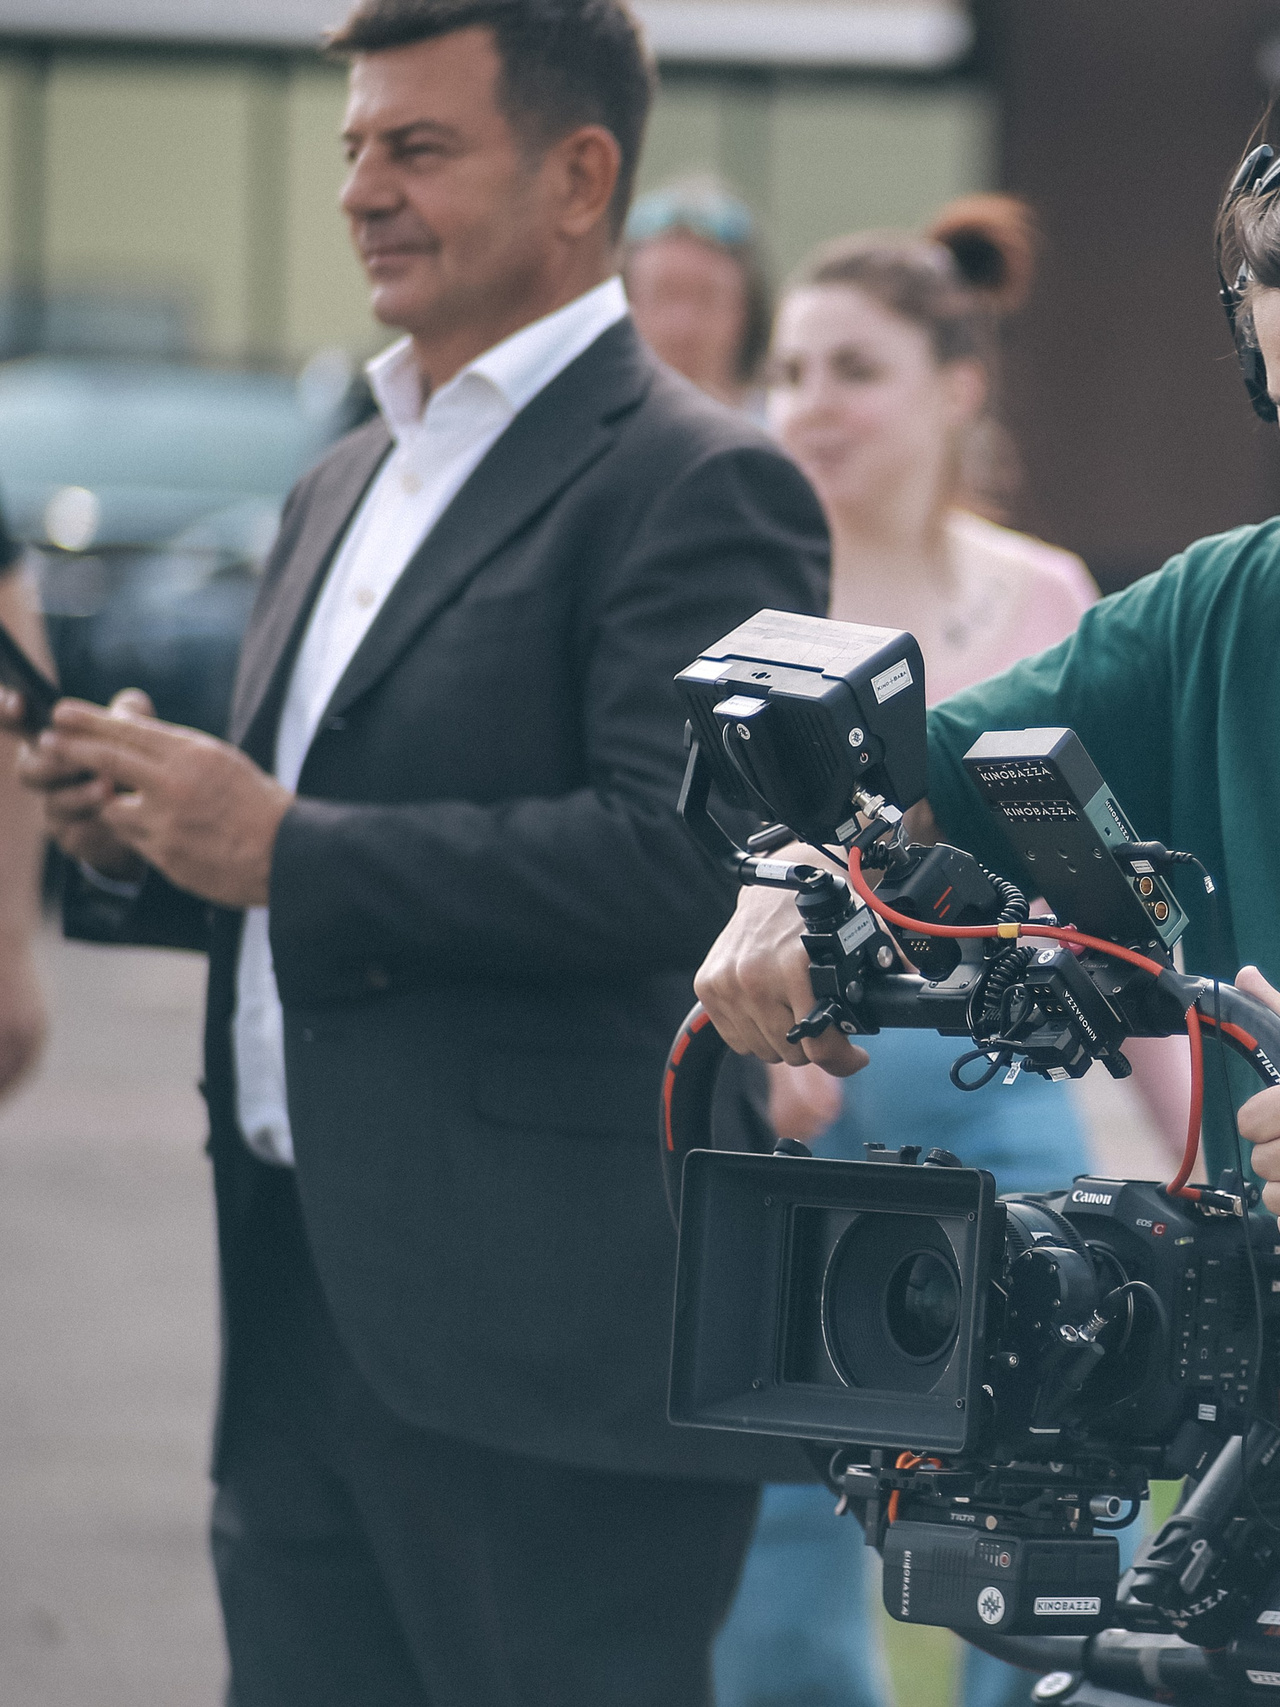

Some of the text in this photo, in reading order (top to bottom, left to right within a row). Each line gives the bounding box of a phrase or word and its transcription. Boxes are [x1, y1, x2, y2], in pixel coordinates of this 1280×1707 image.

[980, 767, 1052, 782] KINOBAZZA
[1003, 807, 1077, 817] KINOBAZZA
[1104, 800, 1130, 842] KINOBAZZA
[1064, 990, 1098, 1042] KINOBAZZA
[1071, 1190, 1113, 1206] Canon
[1136, 1218, 1165, 1235] EOS C
[1036, 1599, 1098, 1612] KINOBAZZA
